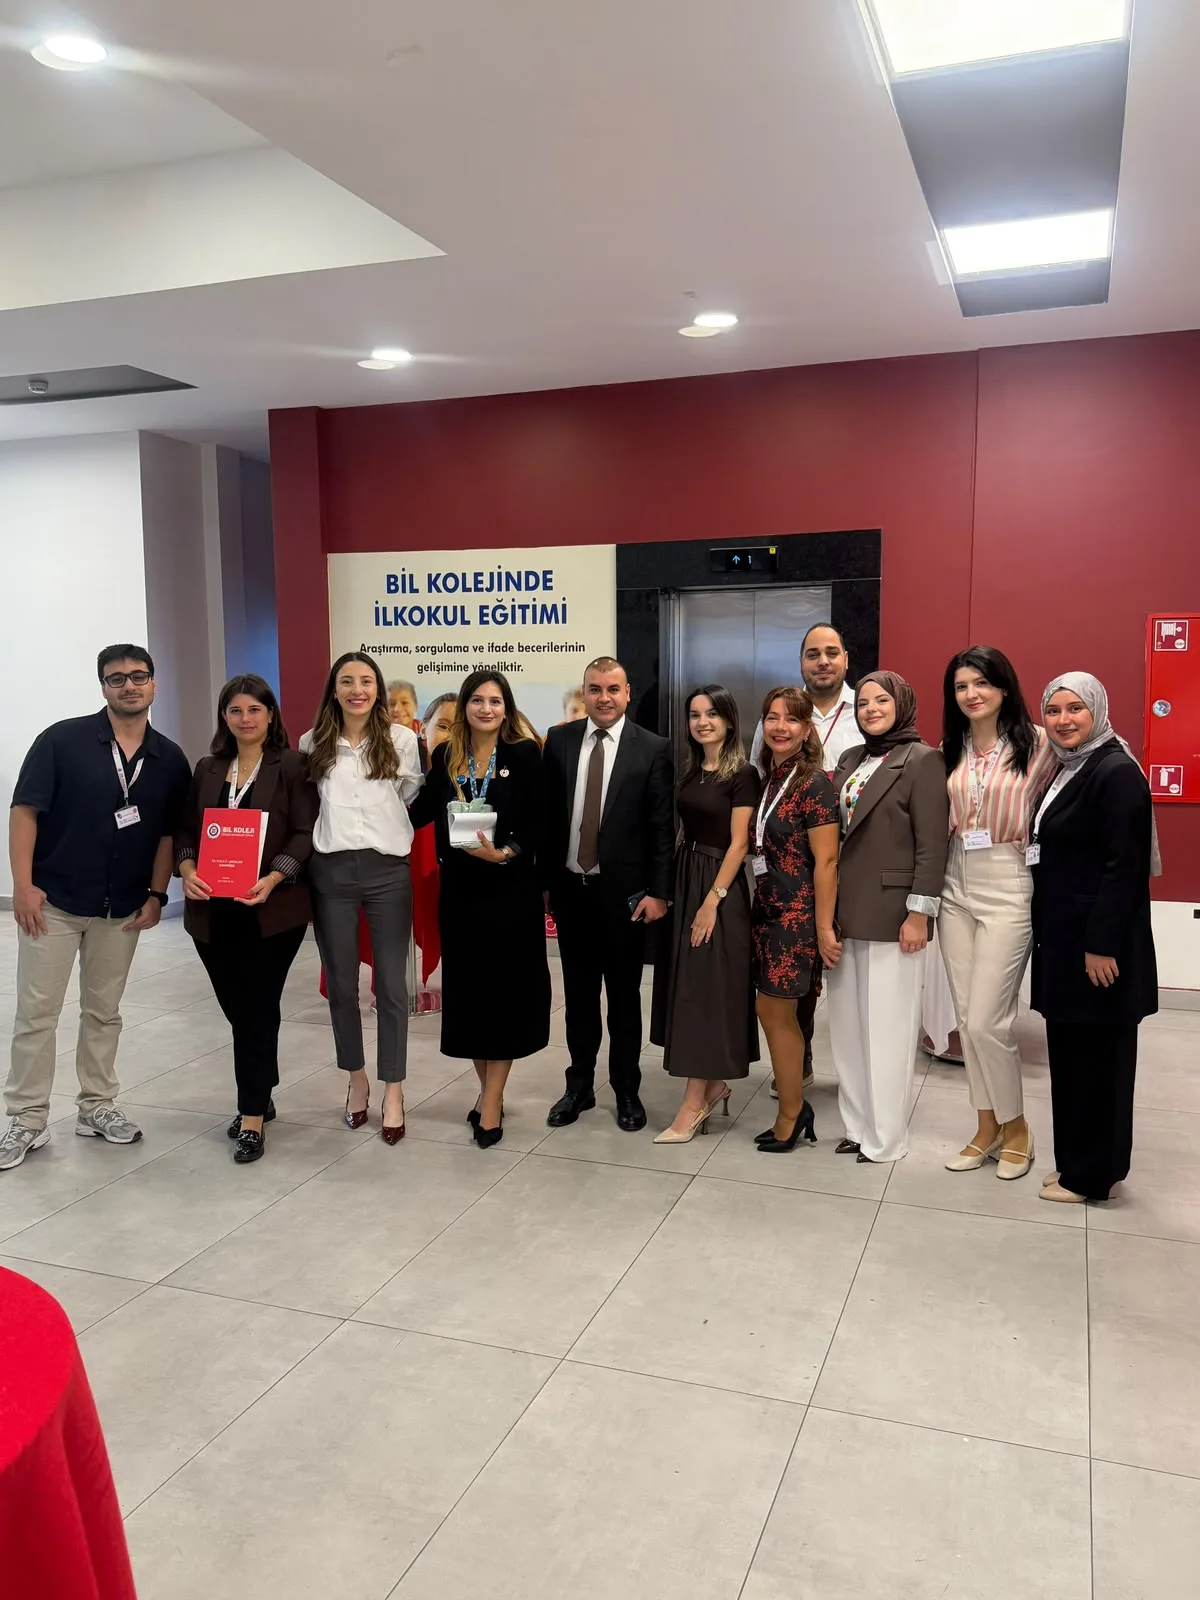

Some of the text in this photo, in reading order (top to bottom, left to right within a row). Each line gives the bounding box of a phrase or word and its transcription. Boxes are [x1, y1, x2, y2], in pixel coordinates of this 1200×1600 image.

[386, 564, 554, 595] BİL KOLEJİNDE
[374, 596, 567, 627] İLKOKUL EĞİTİMİ
[360, 641, 586, 656] Araştırma, sorgulama ve ifade becerilerinin
[417, 661, 469, 674] gelişimine
